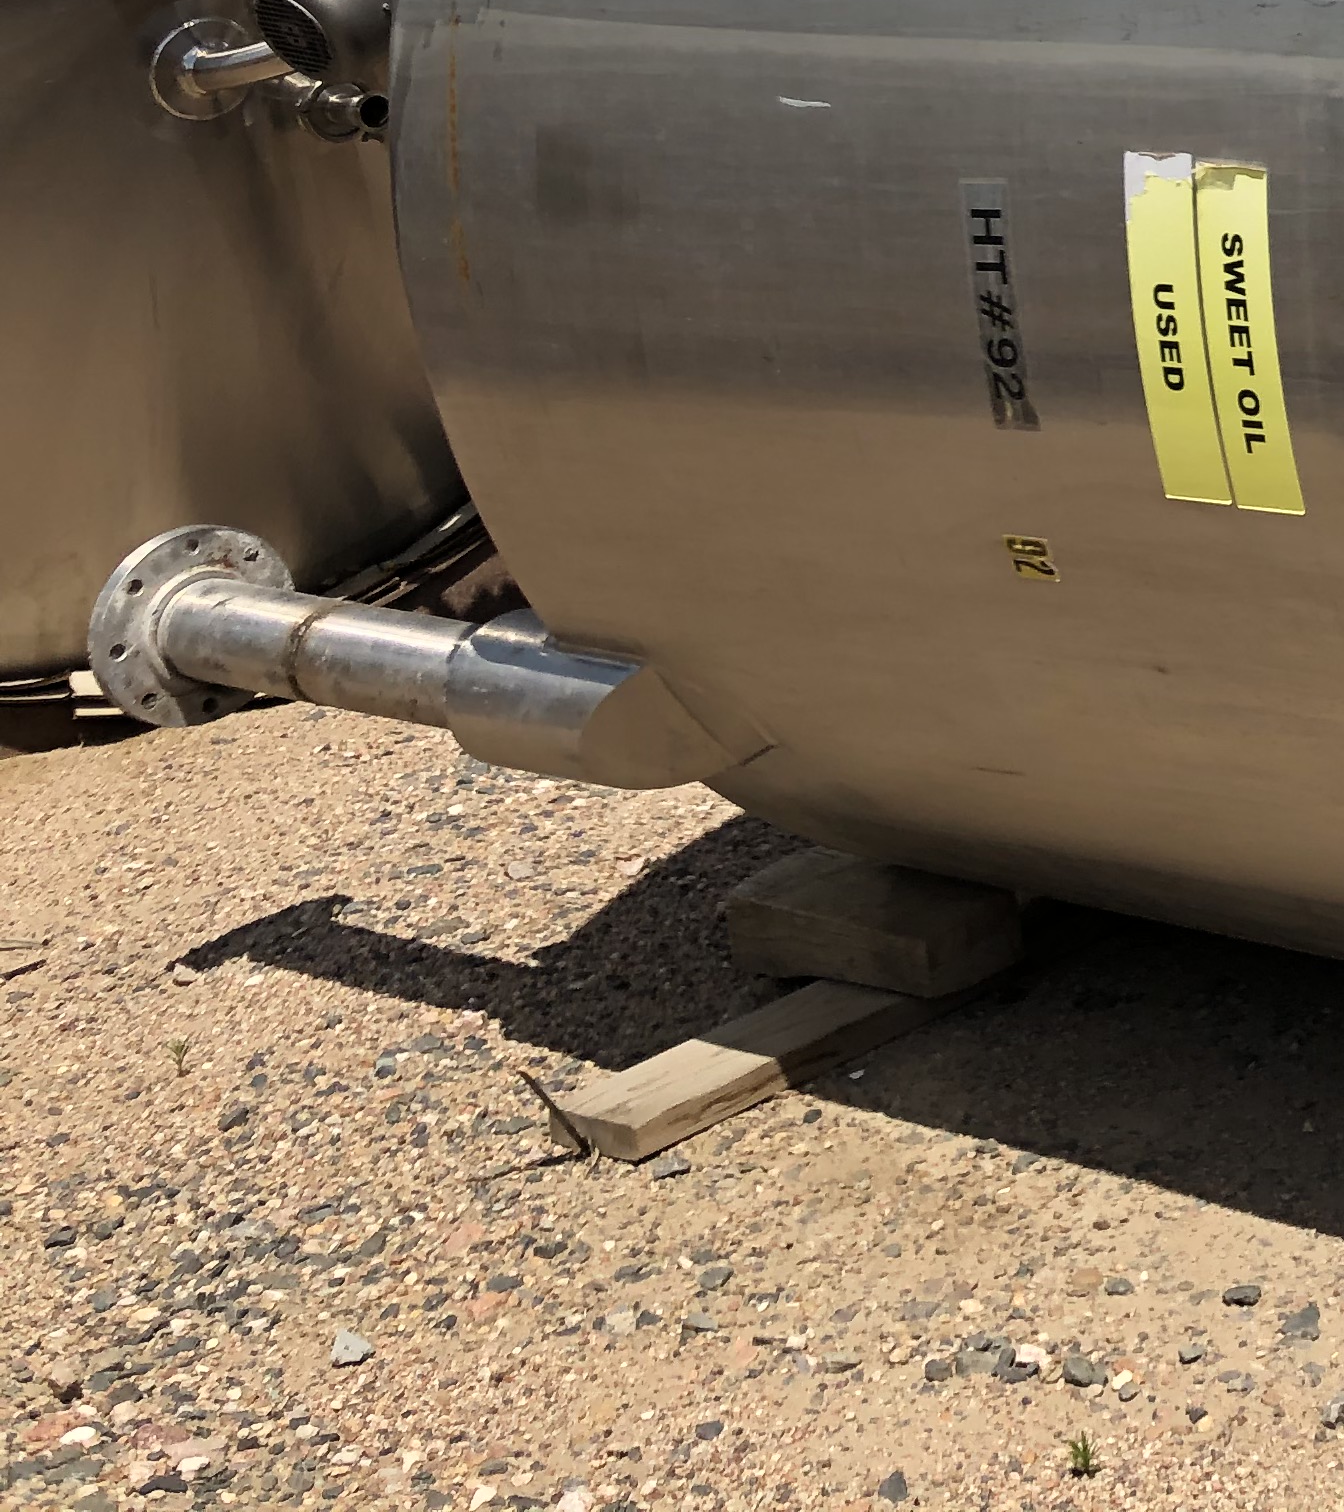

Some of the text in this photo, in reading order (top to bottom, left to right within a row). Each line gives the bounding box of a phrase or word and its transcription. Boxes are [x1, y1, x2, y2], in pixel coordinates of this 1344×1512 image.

[970, 208, 1025, 401] HT#92
[1153, 283, 1186, 392] USED
[1221, 232, 1266, 454] SWEET OIL
